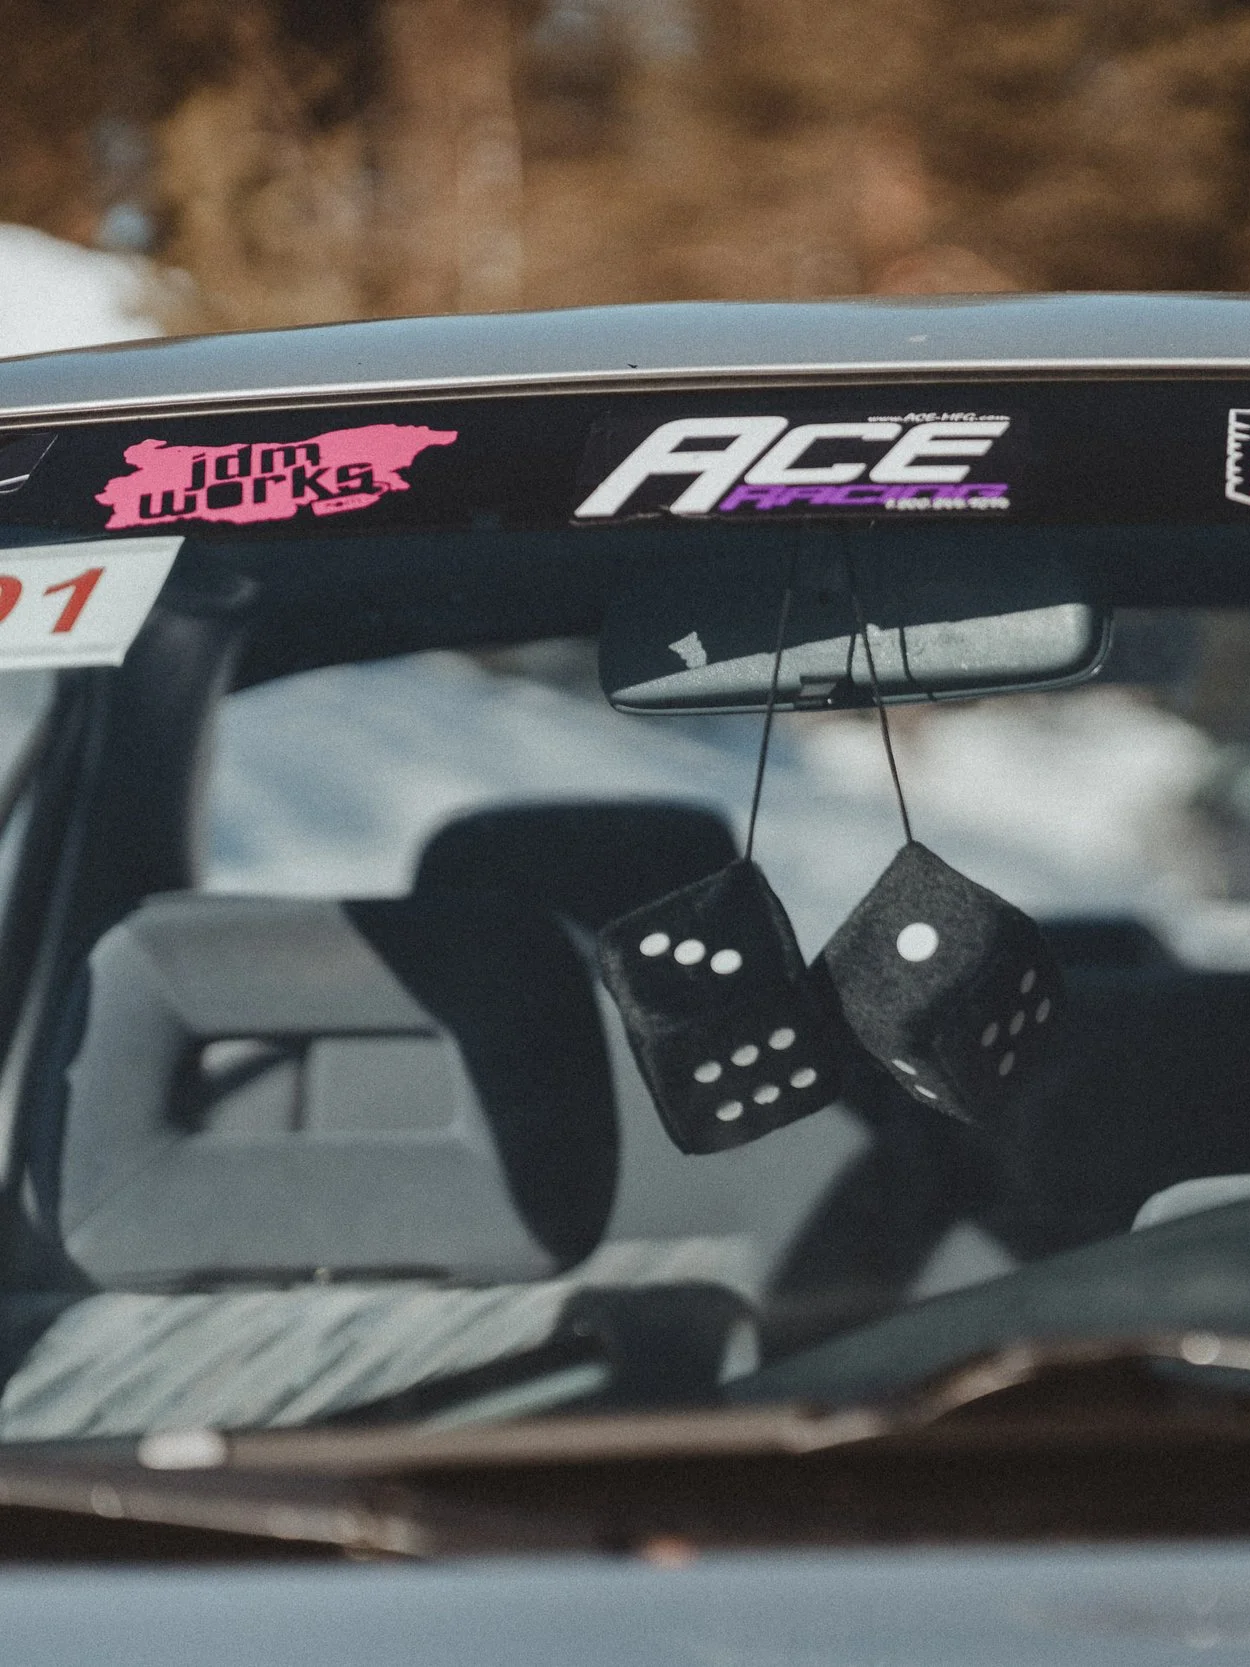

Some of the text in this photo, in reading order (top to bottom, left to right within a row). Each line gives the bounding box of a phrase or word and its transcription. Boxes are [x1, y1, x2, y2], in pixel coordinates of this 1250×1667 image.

[138, 462, 375, 519] works
[190, 443, 321, 492] jdm
[574, 416, 1010, 516] ACE
